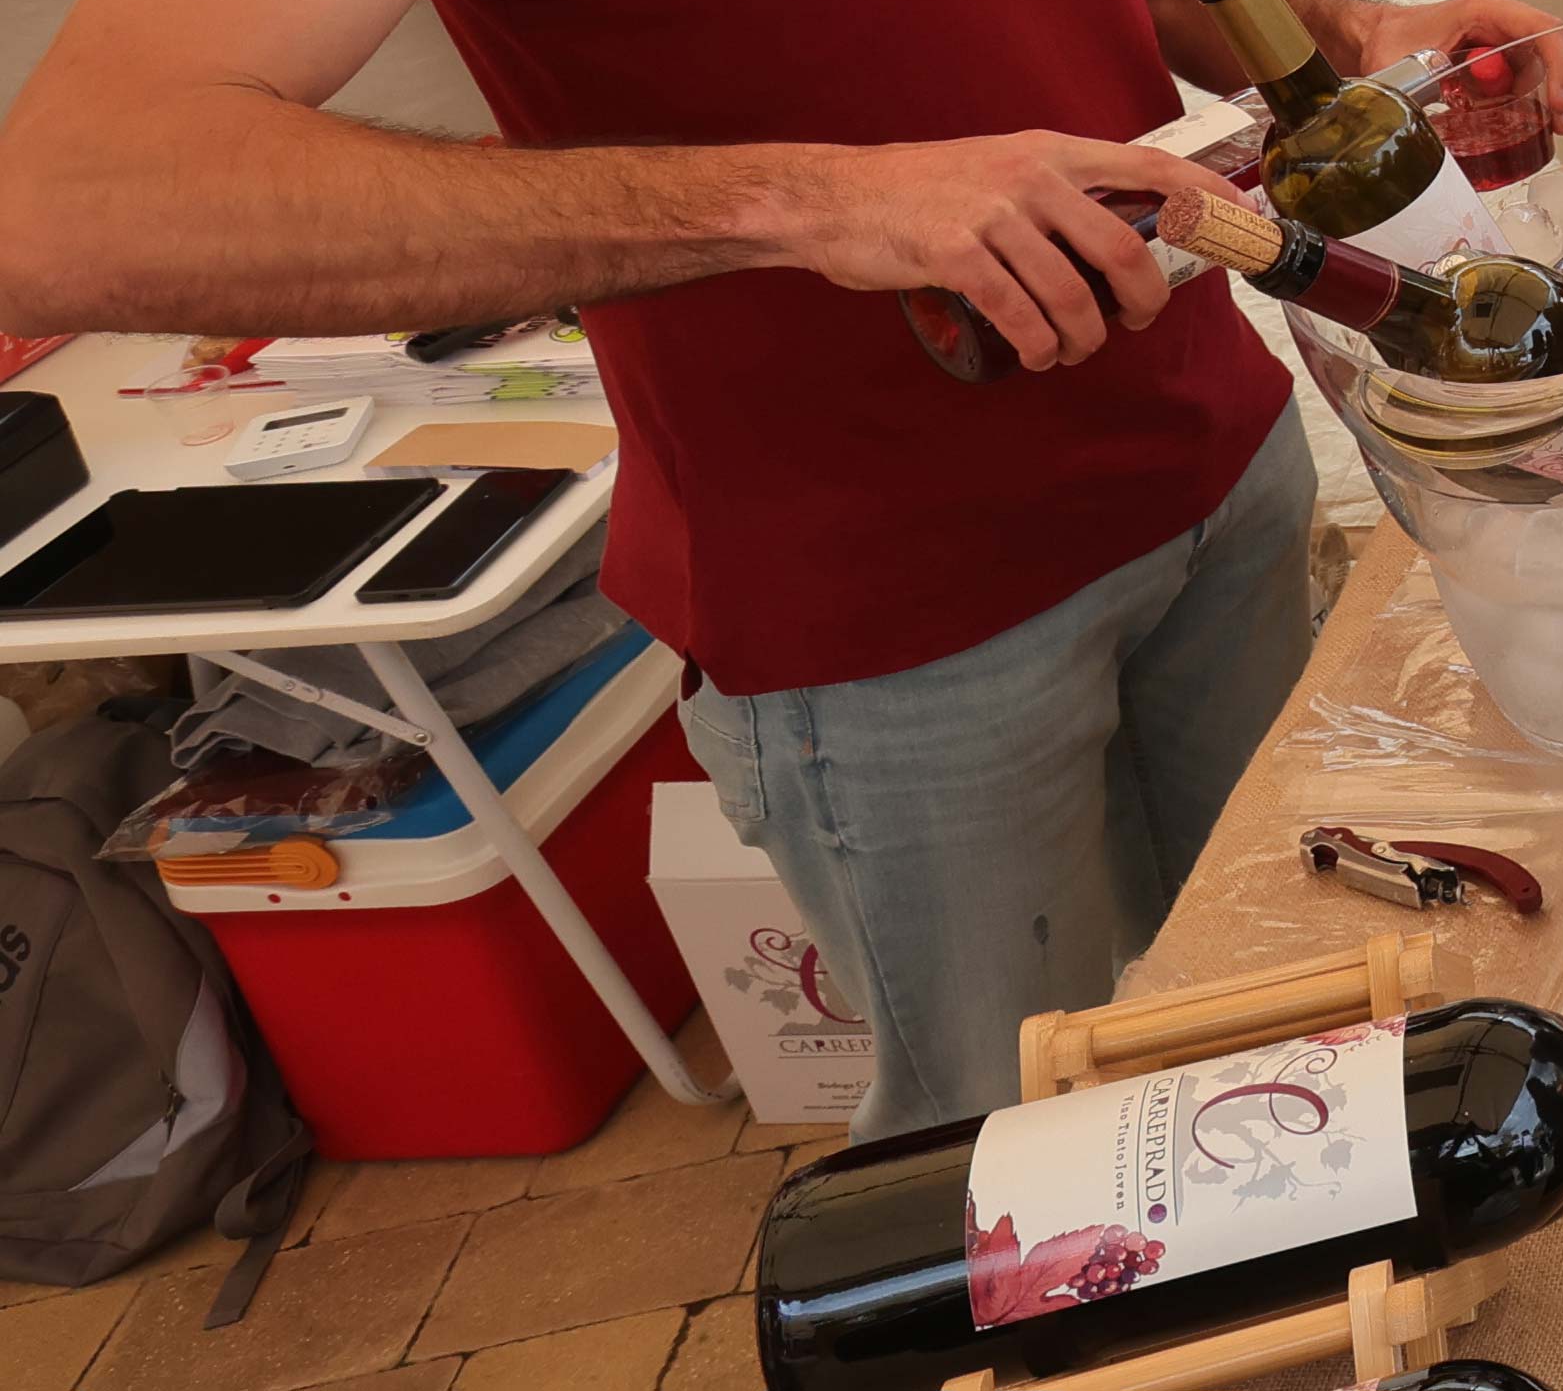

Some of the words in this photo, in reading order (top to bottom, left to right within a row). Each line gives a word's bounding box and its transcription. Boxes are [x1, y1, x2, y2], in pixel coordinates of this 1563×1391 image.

[779, 1039, 872, 1053] CARREP
[1119, 1095, 1134, 1121] Vino
[1115, 1123, 1130, 1161] Tinto
[1145, 1077, 1174, 1224] CARREPRADO
[1115, 1164, 1127, 1210] Joven
